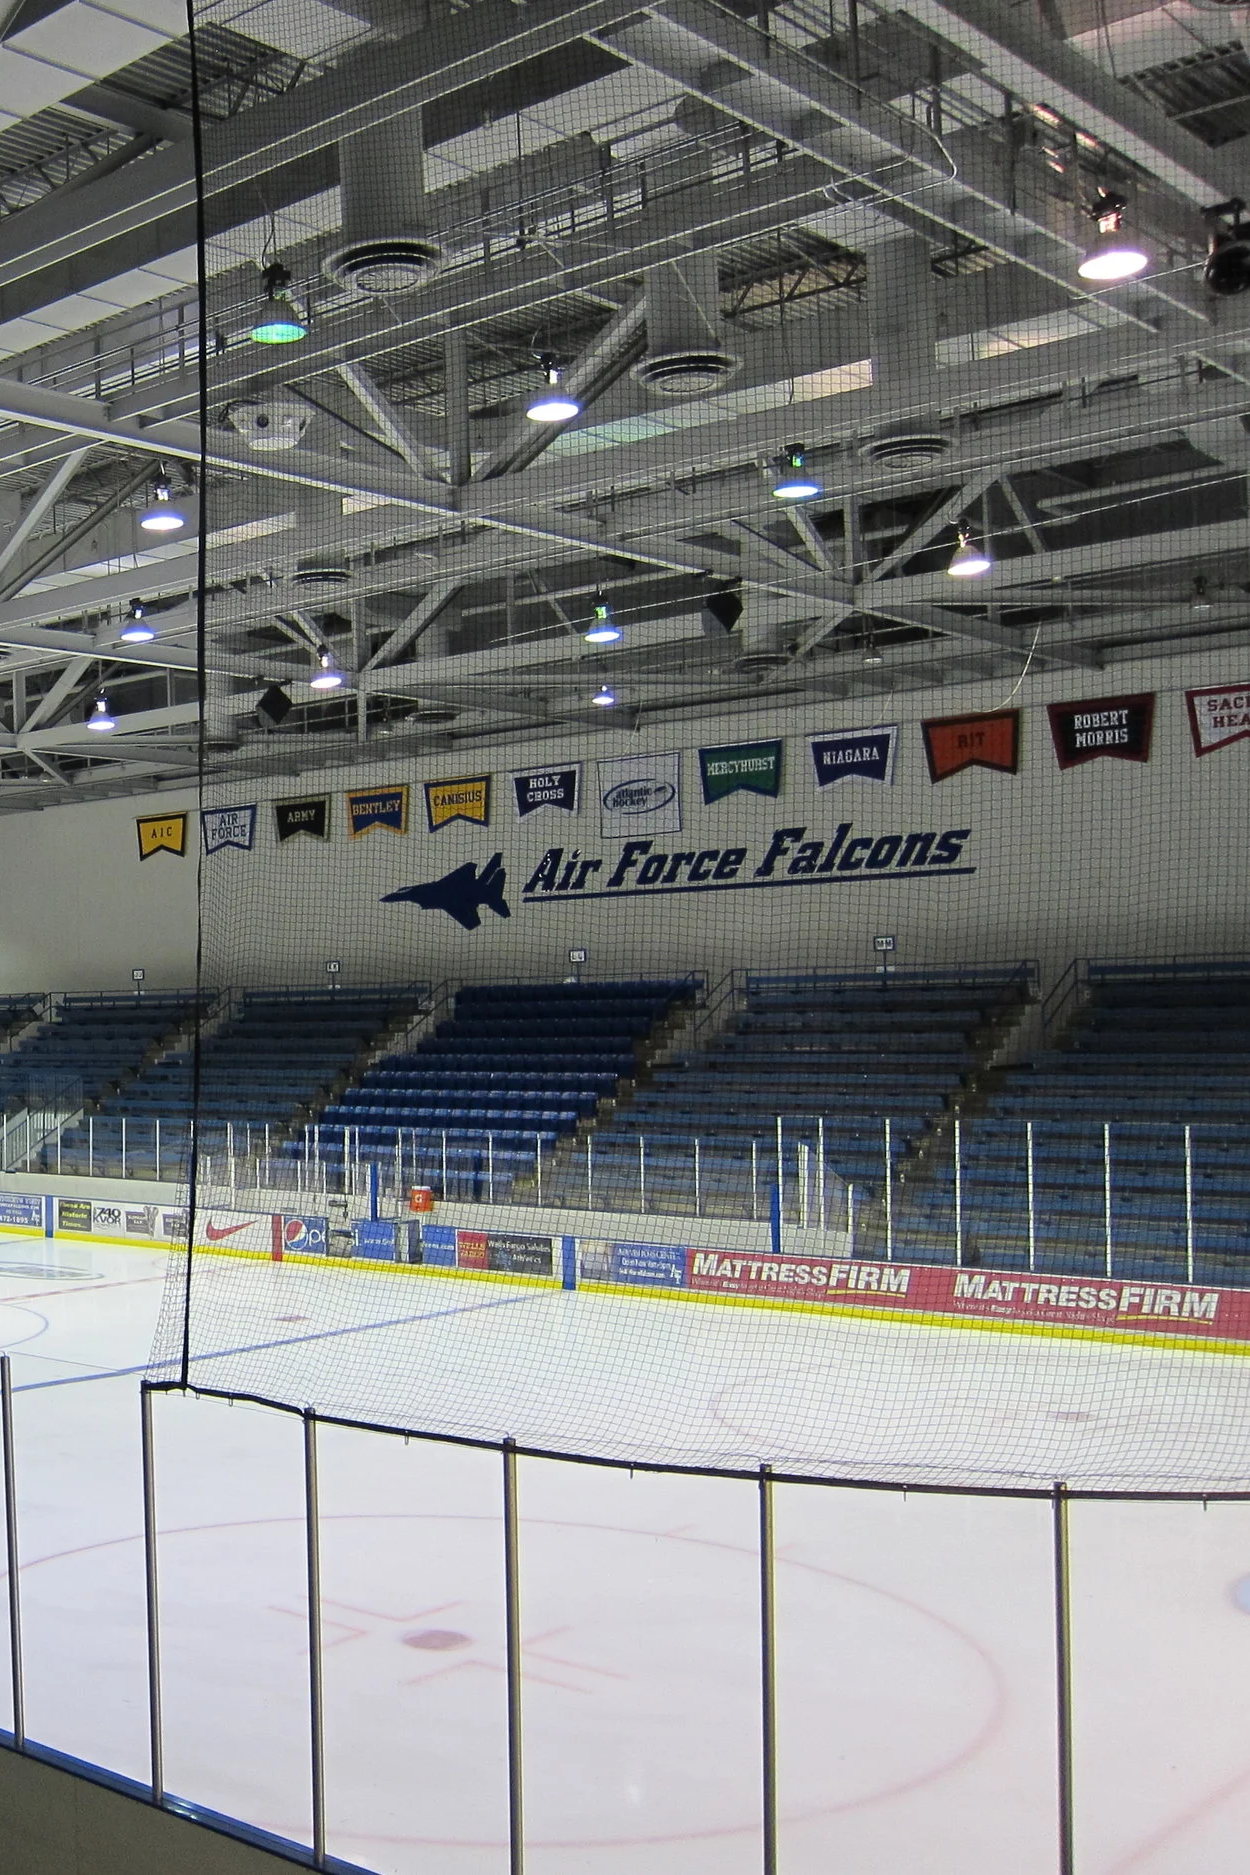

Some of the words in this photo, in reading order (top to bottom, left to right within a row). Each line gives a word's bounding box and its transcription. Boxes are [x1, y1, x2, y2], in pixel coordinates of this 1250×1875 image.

[1073, 710, 1129, 730] ROBERT
[957, 731, 986, 748] RIT
[1075, 728, 1129, 748] MORRIS
[822, 747, 880, 765] NIAGARA
[706, 756, 776, 776] MERCYHURST
[529, 775, 561, 789] HOLY
[433, 790, 484, 807] CANISIUS
[526, 788, 565, 802] CROSS
[616, 786, 652, 799] atlantic
[352, 800, 401, 816] BENTLEY
[613, 797, 648, 808] hockey
[219, 813, 238, 826] AIR
[287, 810, 316, 823] ARMY
[211, 825, 247, 840] FORCE
[522, 848, 602, 893] Air
[606, 840, 747, 887] Force
[754, 823, 972, 878] Falcons
[62, 1211, 87, 1219] Historic
[95, 1207, 121, 1218] 740
[93, 1216, 120, 1224] KVOR
[458, 1241, 486, 1251] WELLS
[506, 1241, 526, 1251] Fargo
[722, 1281, 740, 1290] Easy
